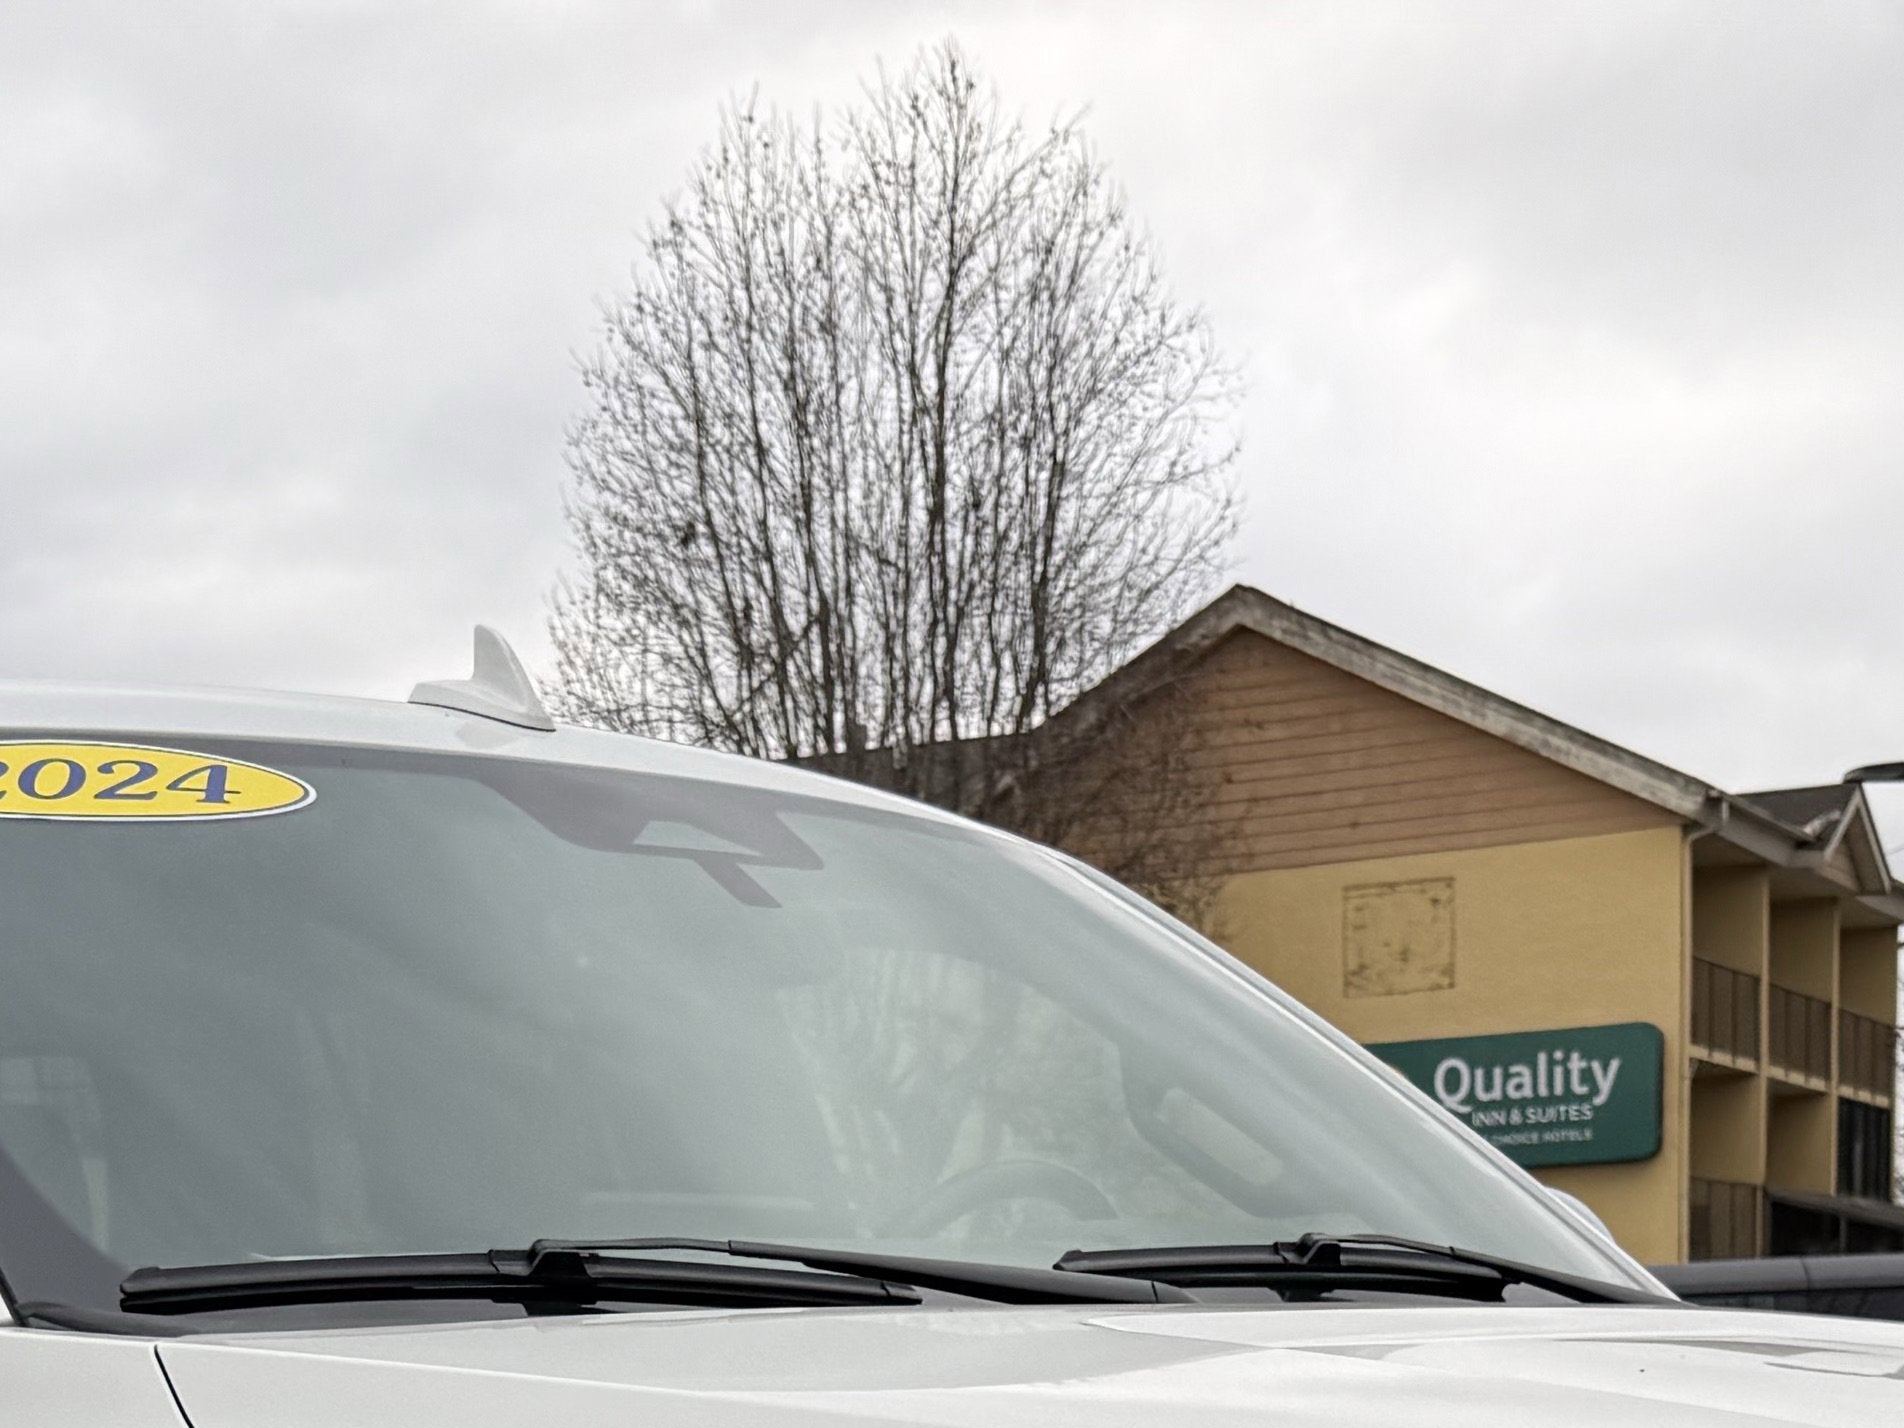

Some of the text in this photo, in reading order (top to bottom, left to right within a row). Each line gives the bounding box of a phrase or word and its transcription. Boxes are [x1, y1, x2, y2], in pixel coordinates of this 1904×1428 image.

[1434, 1050, 1621, 1113] Quality
[1472, 1102, 1594, 1126] INN & SUITES
